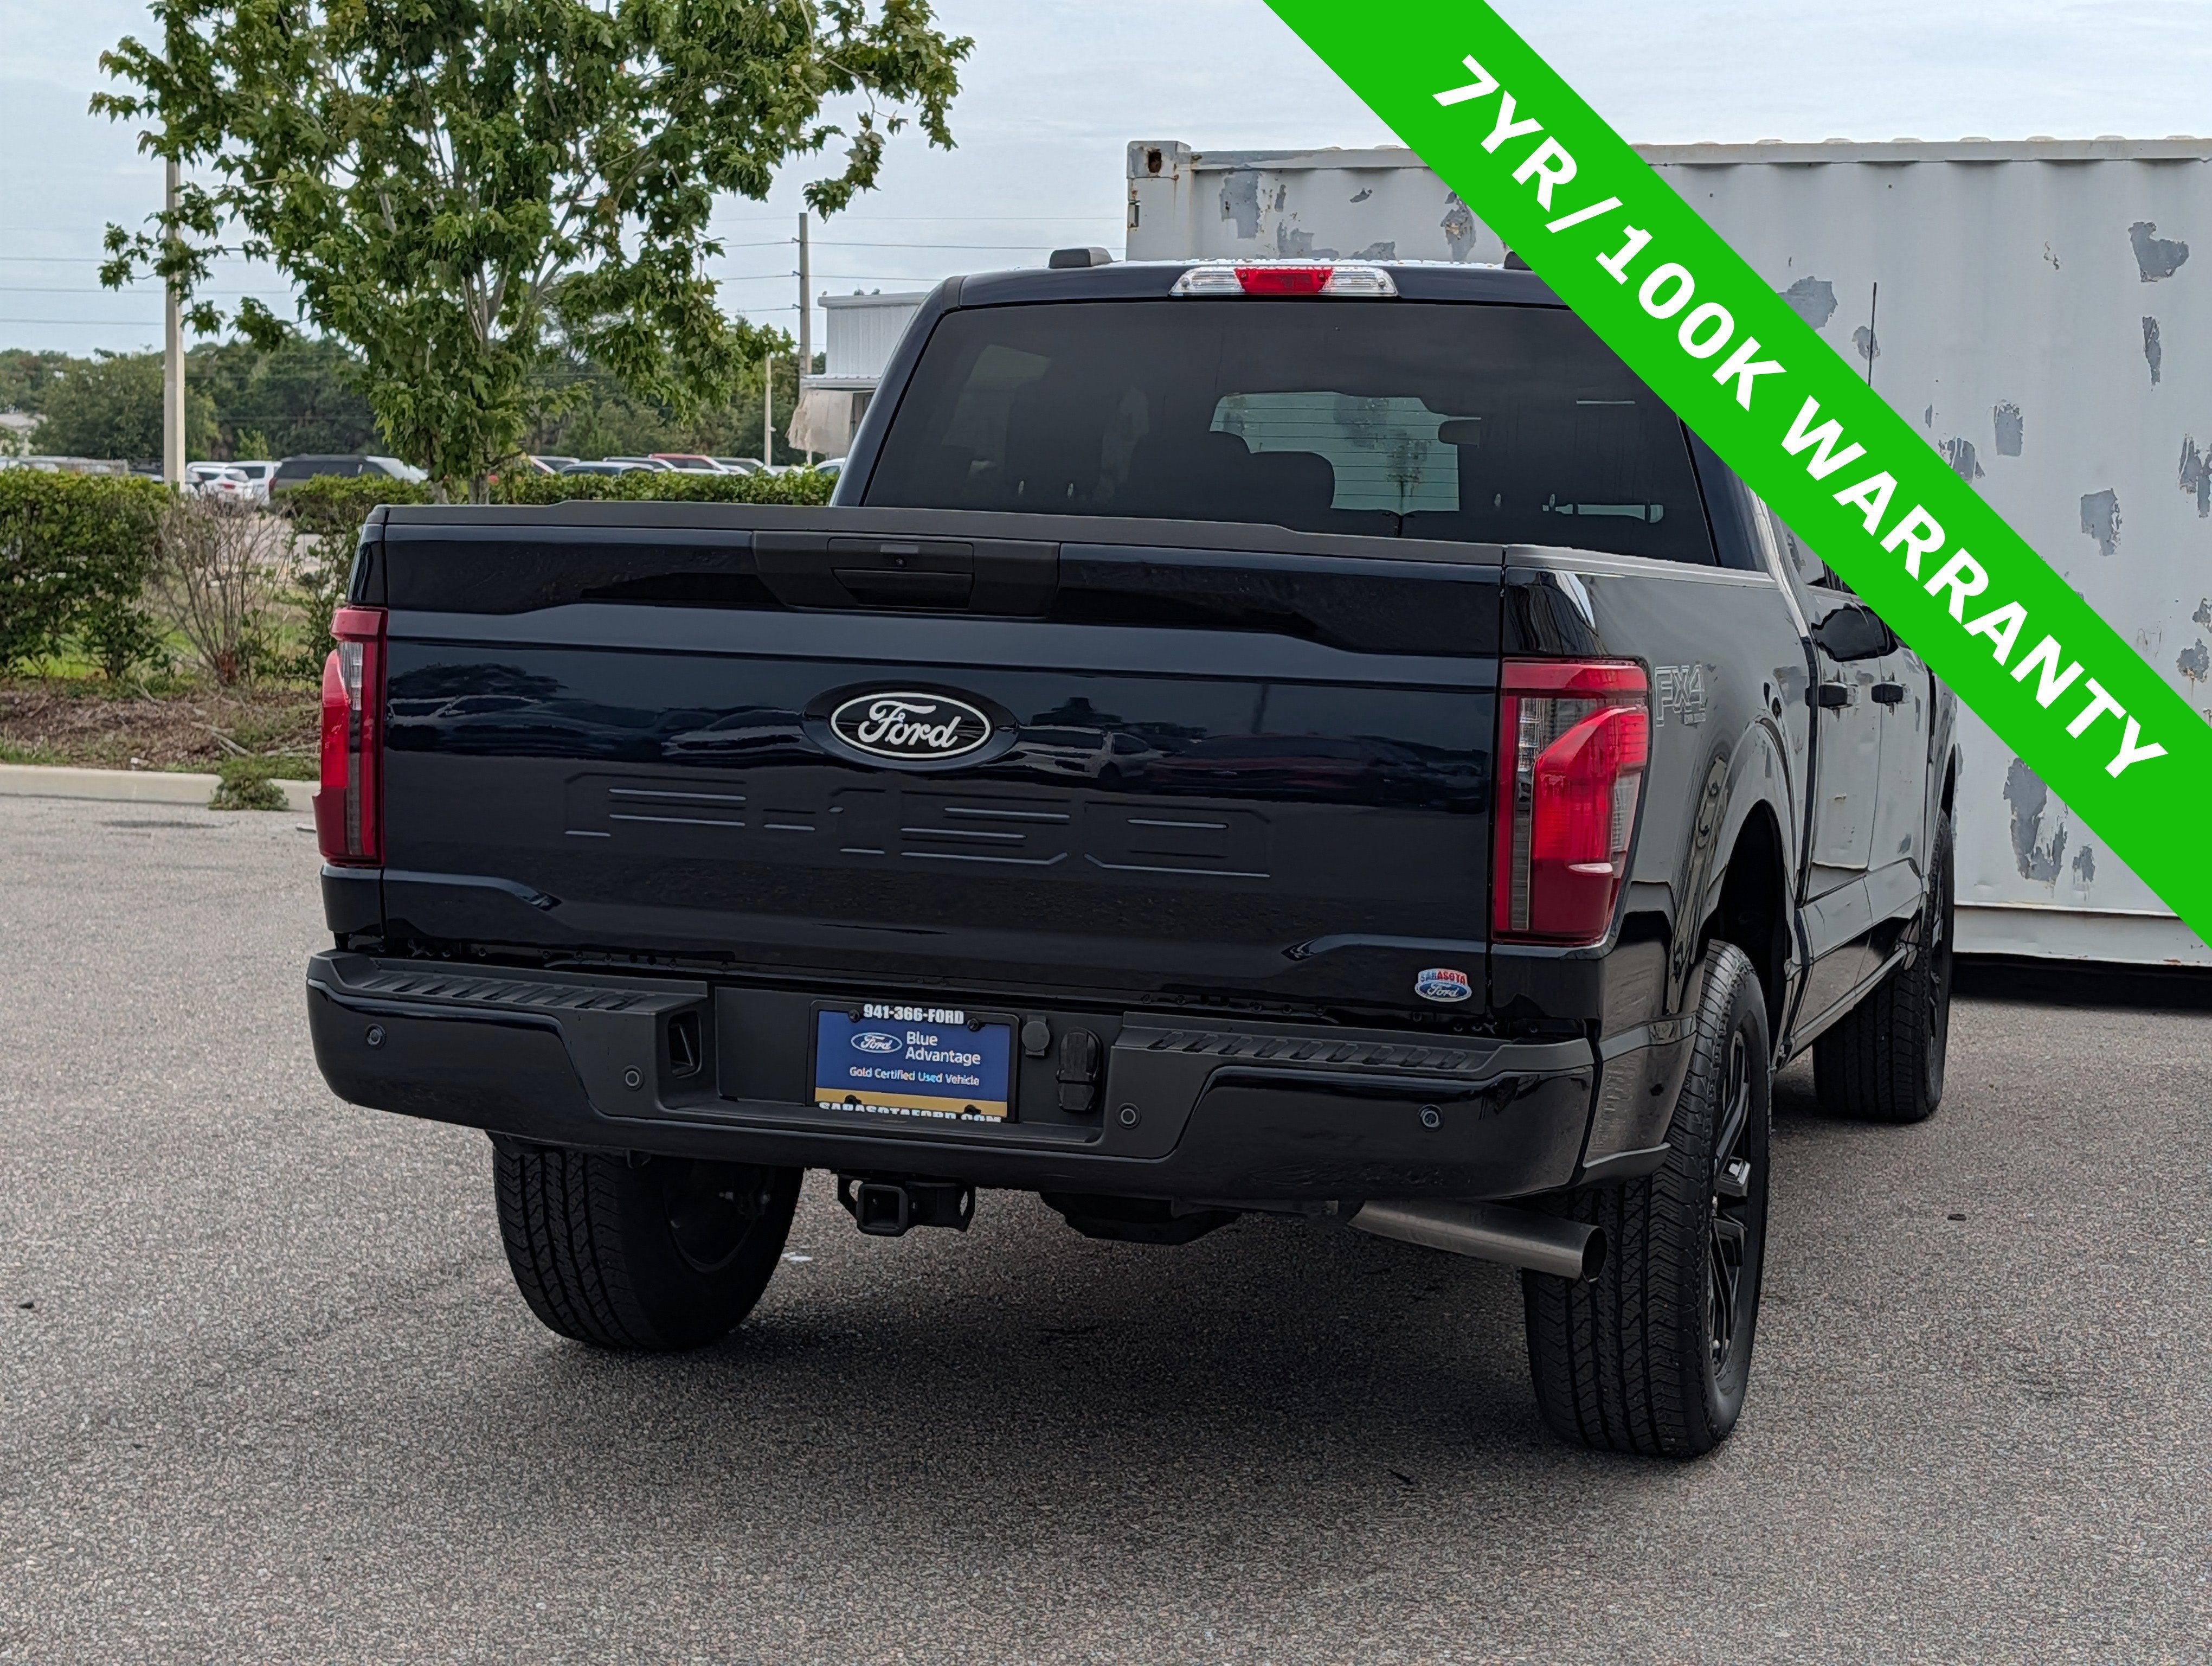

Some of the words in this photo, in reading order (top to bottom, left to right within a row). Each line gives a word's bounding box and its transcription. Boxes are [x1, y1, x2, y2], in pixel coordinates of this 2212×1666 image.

[1655, 664, 1706, 727] FX4
[858, 700, 961, 748] Ford
[1420, 970, 1465, 984] SARASOTA
[1426, 983, 1459, 997] Ford
[863, 1003, 964, 1025] 941-366-FORD
[860, 1035, 892, 1051] Ford
[906, 1031, 938, 1047] Blue
[905, 1047, 981, 1067] Advantage
[849, 1066, 872, 1078] Gold
[874, 1068, 915, 1082] Certified
[918, 1072, 943, 1084] Used
[945, 1074, 980, 1087] Vehicle
